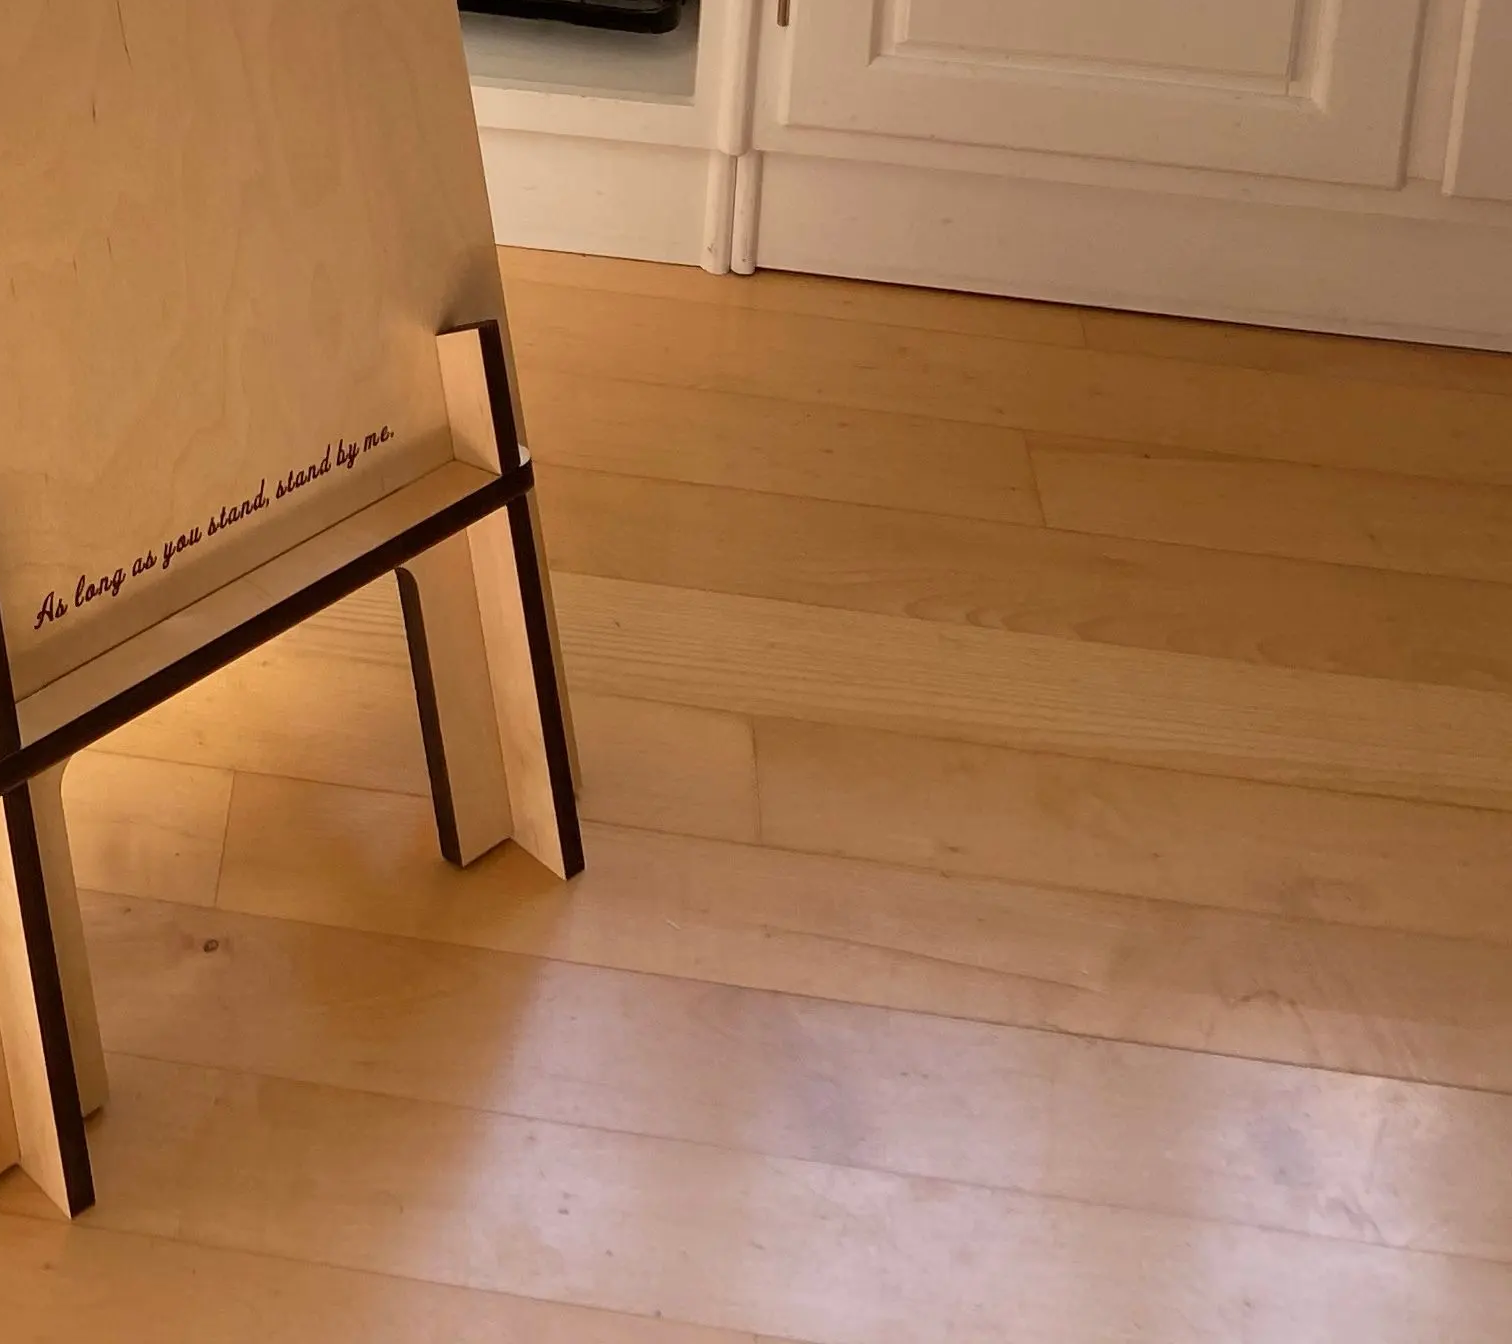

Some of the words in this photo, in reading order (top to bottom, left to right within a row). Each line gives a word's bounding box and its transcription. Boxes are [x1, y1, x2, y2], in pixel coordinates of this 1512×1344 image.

[33, 589, 69, 632] As
[74, 565, 127, 610] long
[131, 554, 158, 579] as
[163, 528, 203, 569] you
[207, 479, 272, 536] stand,
[276, 445, 332, 501] stand
[336, 434, 360, 470] by
[363, 423, 395, 455] me.
